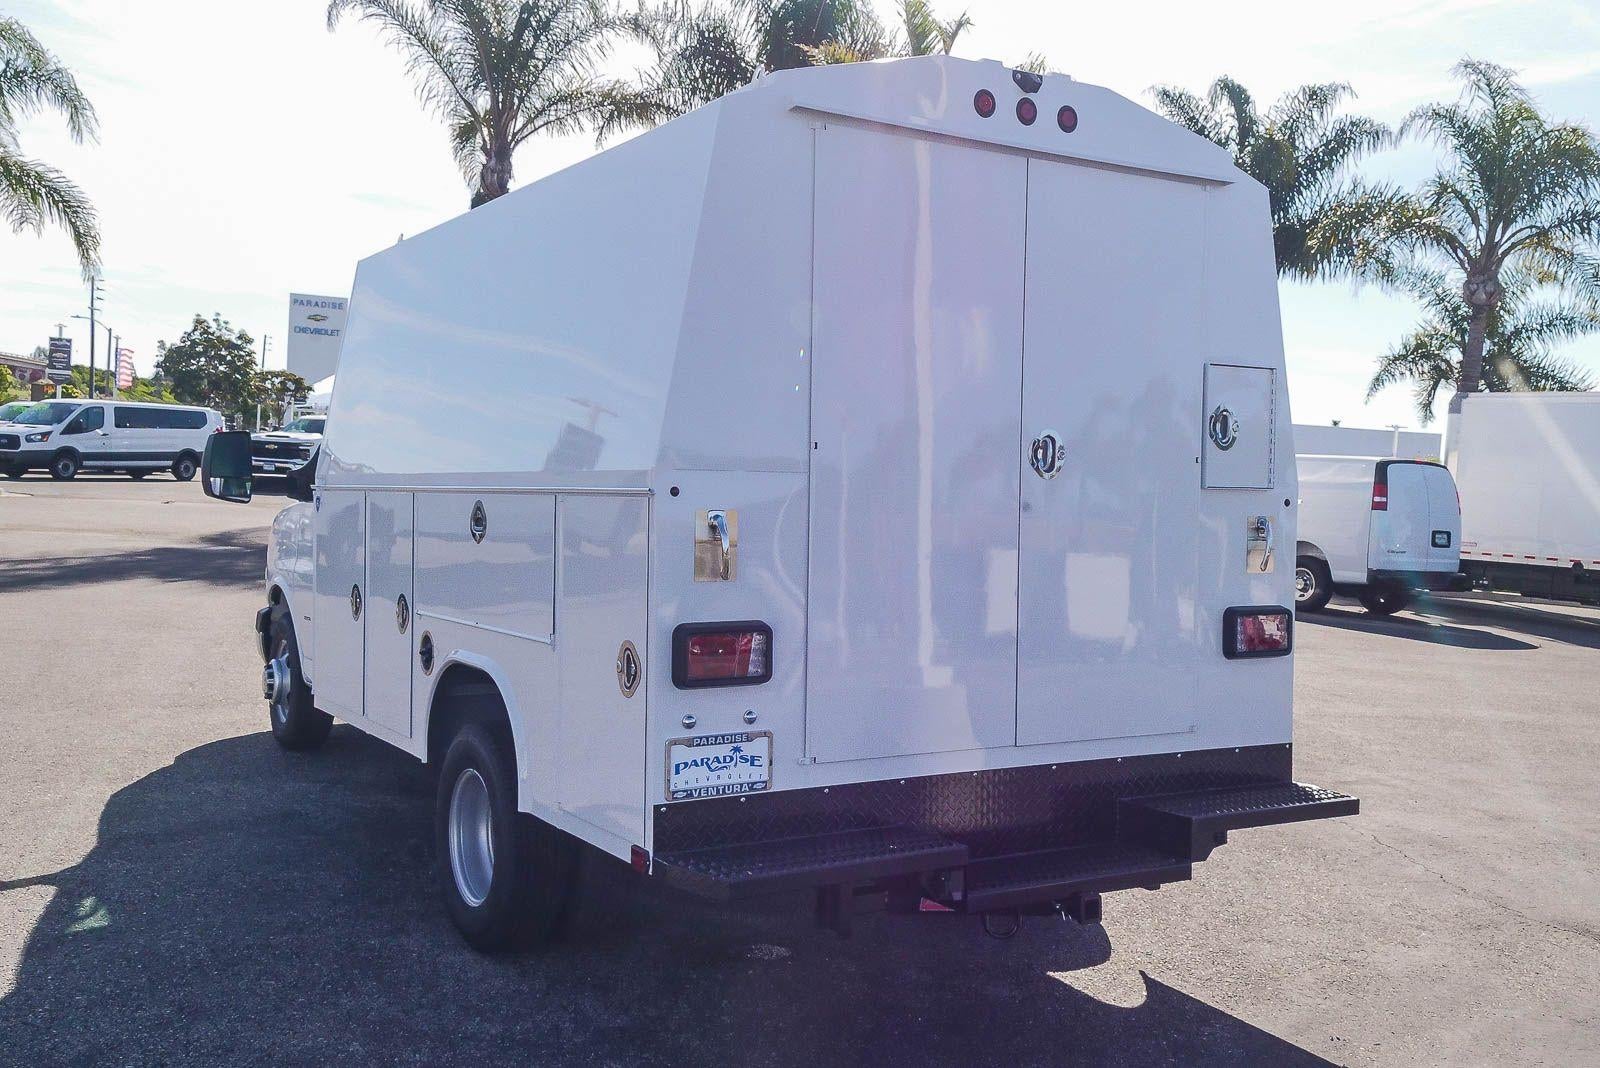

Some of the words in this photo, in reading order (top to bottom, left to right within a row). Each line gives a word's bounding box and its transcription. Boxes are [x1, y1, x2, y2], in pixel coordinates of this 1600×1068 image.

[293, 298, 344, 310] PARADISE
[293, 325, 341, 337] CHEVROLET
[693, 733, 749, 746] PARADISE
[674, 745, 763, 775] PARADISE
[673, 773, 763, 789] CHEVROLET
[692, 783, 750, 797] VENTURA
